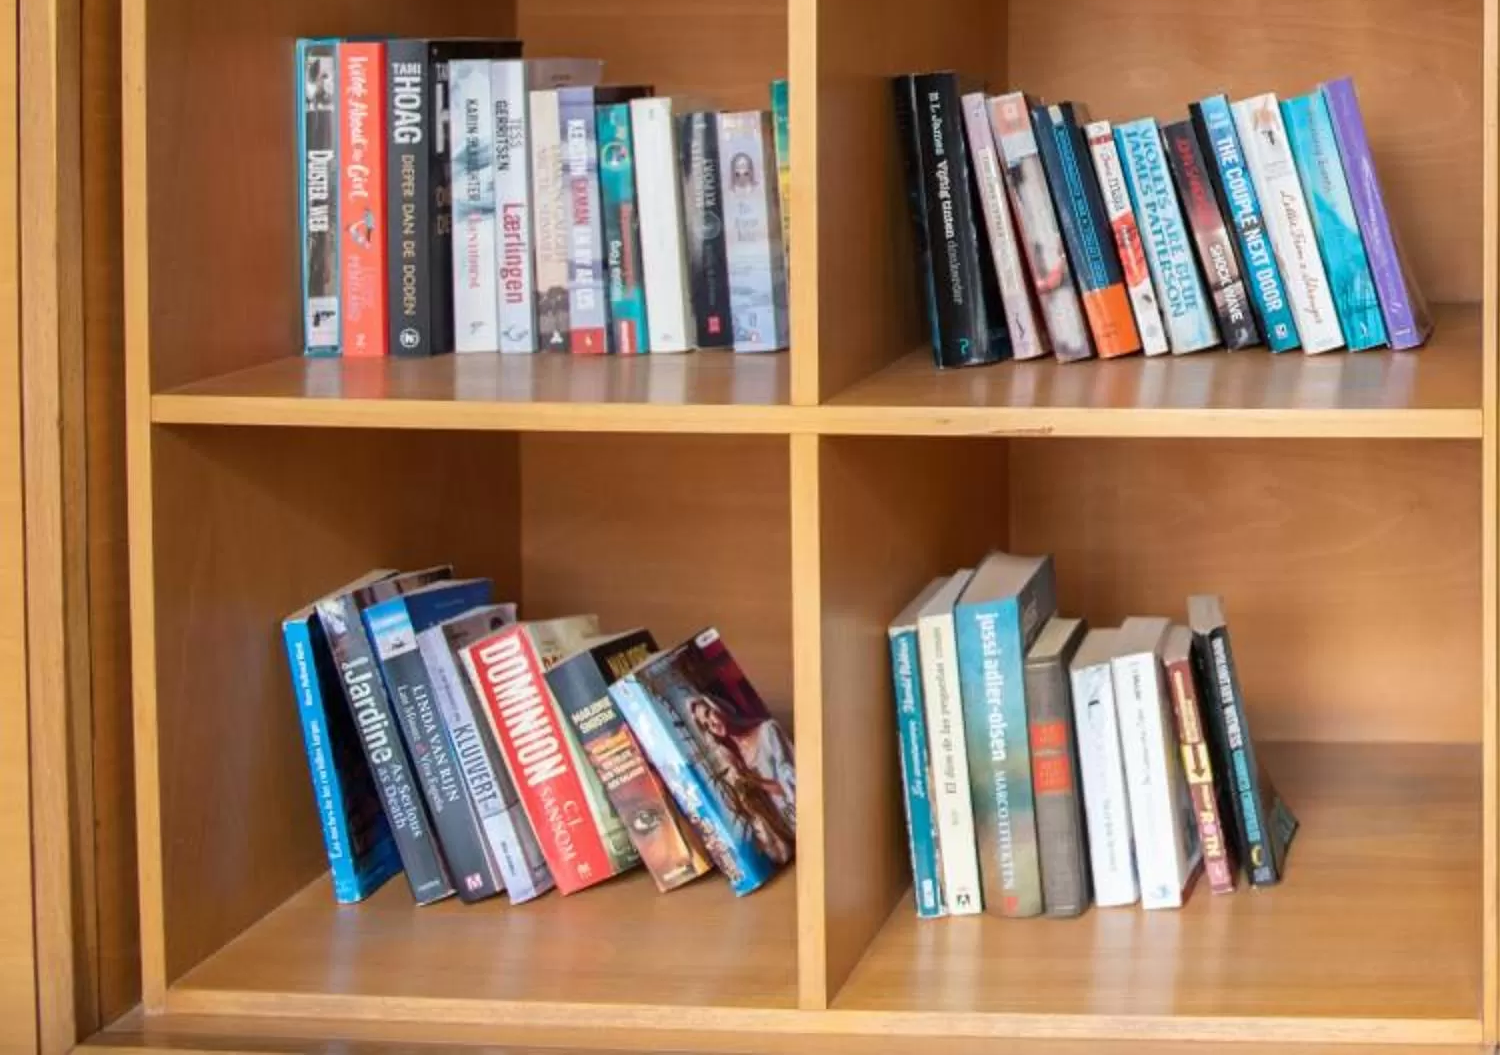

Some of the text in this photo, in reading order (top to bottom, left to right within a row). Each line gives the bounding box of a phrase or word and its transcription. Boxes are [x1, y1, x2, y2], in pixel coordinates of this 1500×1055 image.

[392, 62, 421, 75] TAMI
[346, 99, 371, 200] About Girl
[392, 75, 422, 144] HOAG
[464, 98, 481, 135] KARIN
[495, 99, 511, 172] GERRITSEN
[508, 117, 524, 149] TESS
[465, 137, 483, 202] SLAUGHTER
[931, 116, 947, 156] James
[939, 199, 956, 239] tinten
[401, 153, 417, 316] DIEPER DAN DE DODEN
[499, 201, 527, 305] Lærlingen
[1125, 130, 1186, 318] JAMES PATTERSON
[1144, 128, 1200, 311] VIOLETS ARE BLUE
[1215, 136, 1284, 313] THE COUPLE NEXT DOOR
[1208, 243, 1244, 324] SHOCK WAVE
[1299, 271, 1325, 325] Stranger
[343, 672, 392, 764] Jardine
[478, 634, 568, 788] DOMINION
[976, 612, 1008, 761] jussi adler-olsen
[411, 684, 461, 802] LINDA VAN RIJN
[450, 721, 499, 802] KLUIVERT
[376, 767, 409, 830] as Death
[390, 762, 423, 838] As Serious
[539, 785, 578, 862] SANSOM
[1198, 810, 1222, 857] ROTH
